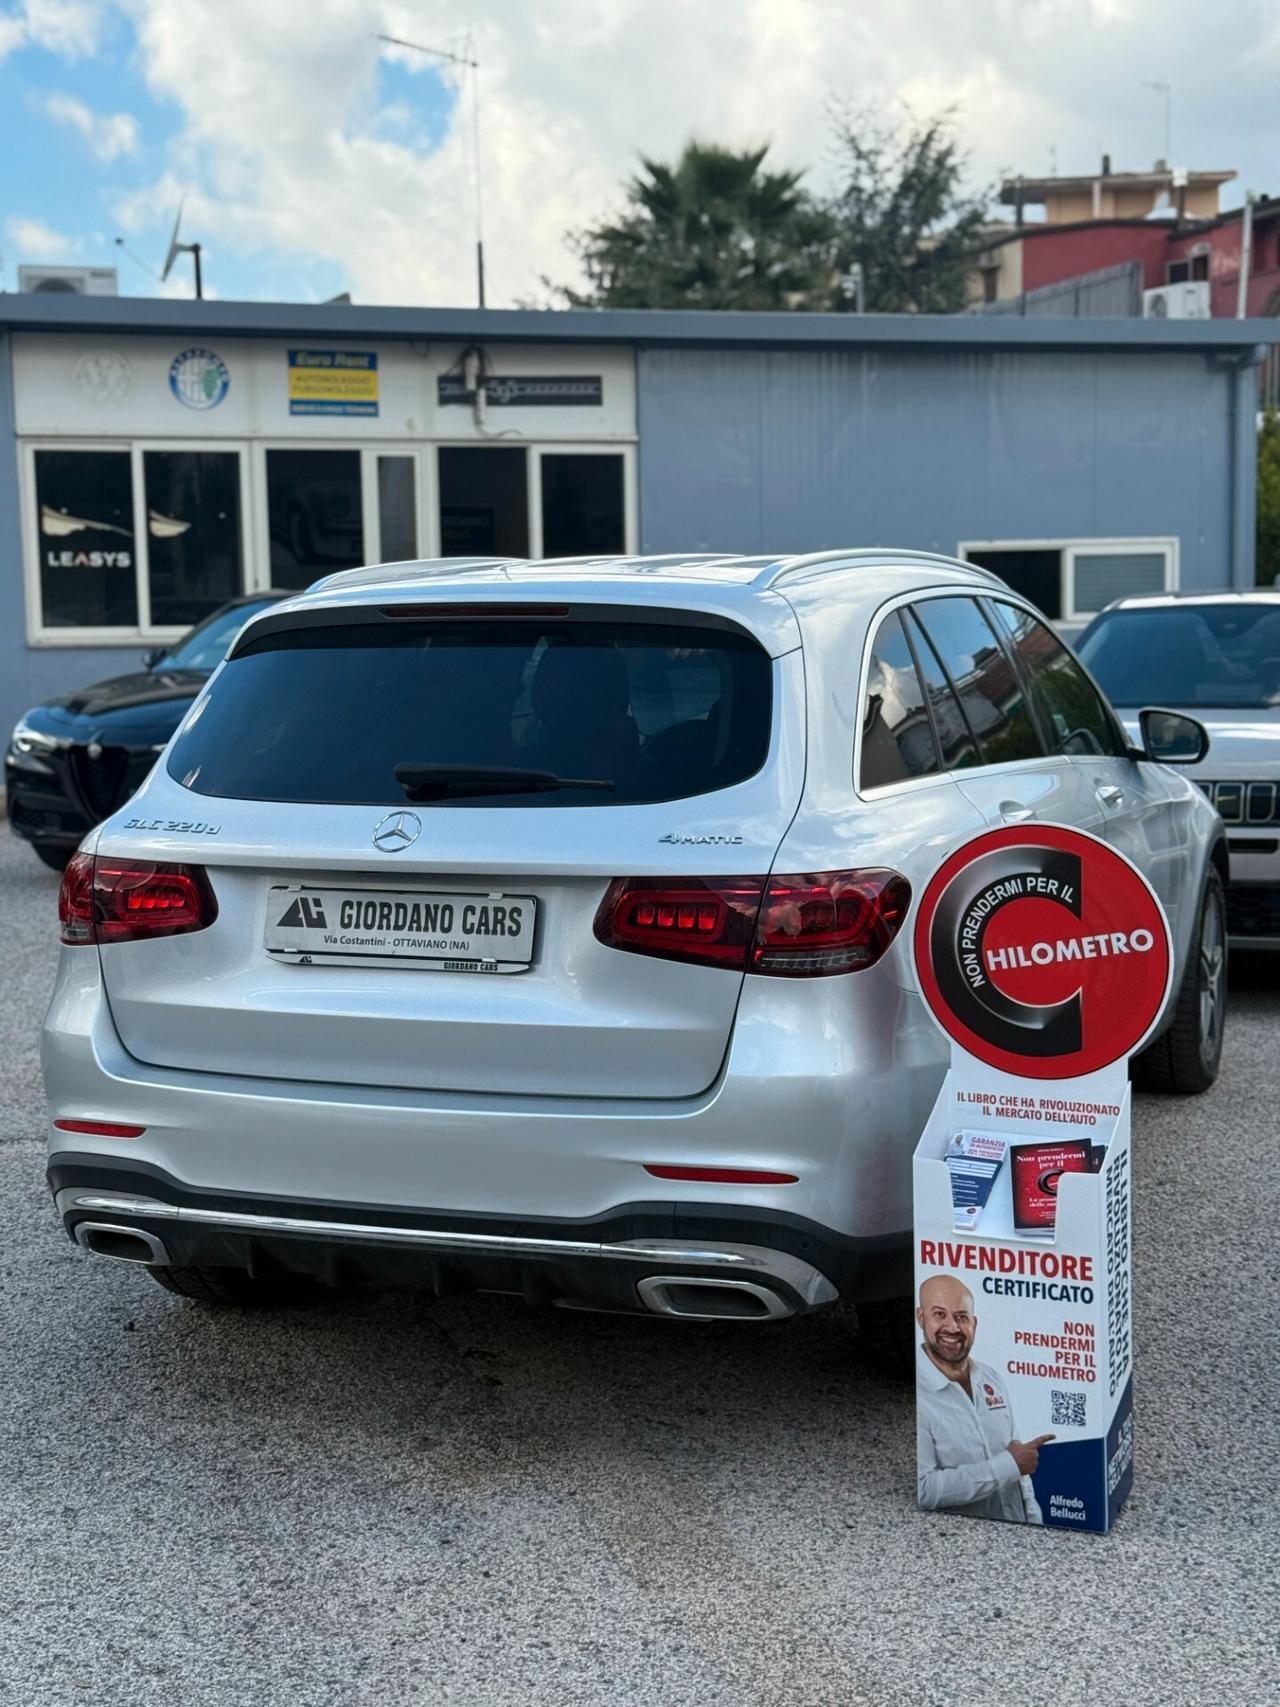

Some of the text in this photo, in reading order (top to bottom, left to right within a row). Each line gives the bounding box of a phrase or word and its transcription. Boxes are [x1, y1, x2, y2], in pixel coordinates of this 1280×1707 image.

[296, 352, 369, 368] Euro Rent
[47, 551, 131, 568] LEASYS
[123, 819, 222, 835] GLC 220d
[658, 832, 743, 845] 4MATIC
[340, 900, 522, 937] GIORDANO CARS
[962, 877, 1075, 988] NON PRENDERMI PER IL
[324, 934, 338, 945] Via
[340, 935, 386, 947] Costantini
[393, 938, 448, 950] OTTAVIANO
[449, 940, 470, 952] (NA)
[443, 961, 498, 972] GIORDANO CARS
[957, 1091, 1121, 1117] IL LIBRO CHE HA RIVOLUZIONATO
[982, 1105, 1097, 1126] IL MERCATO DELL'AUTO
[970, 1136, 1006, 1147] GARANZIA
[1016, 1150, 1086, 1163] Non prendermi
[1039, 1161, 1056, 1170] per
[1120, 1148, 1128, 1177] IL
[1120, 1178, 1128, 1264] LIBRO
[920, 1240, 1094, 1282] RIVENDITORE
[1113, 1154, 1123, 1387] RIVOLUZIONATO IL
[982, 1276, 1094, 1305] CERTIFICATO
[1064, 1321, 1095, 1337] NON
[1107, 1279, 1116, 1398] DELL'AUTO
[1014, 1331, 1095, 1353] PRENDERMI
[1055, 1351, 1097, 1368] PER IL
[1122, 1329, 1129, 1375] HA
[1007, 1360, 1096, 1383] CHILOMETRO
[1050, 1494, 1084, 1509] Alfredo
[1050, 1506, 1086, 1521] Bellucci
